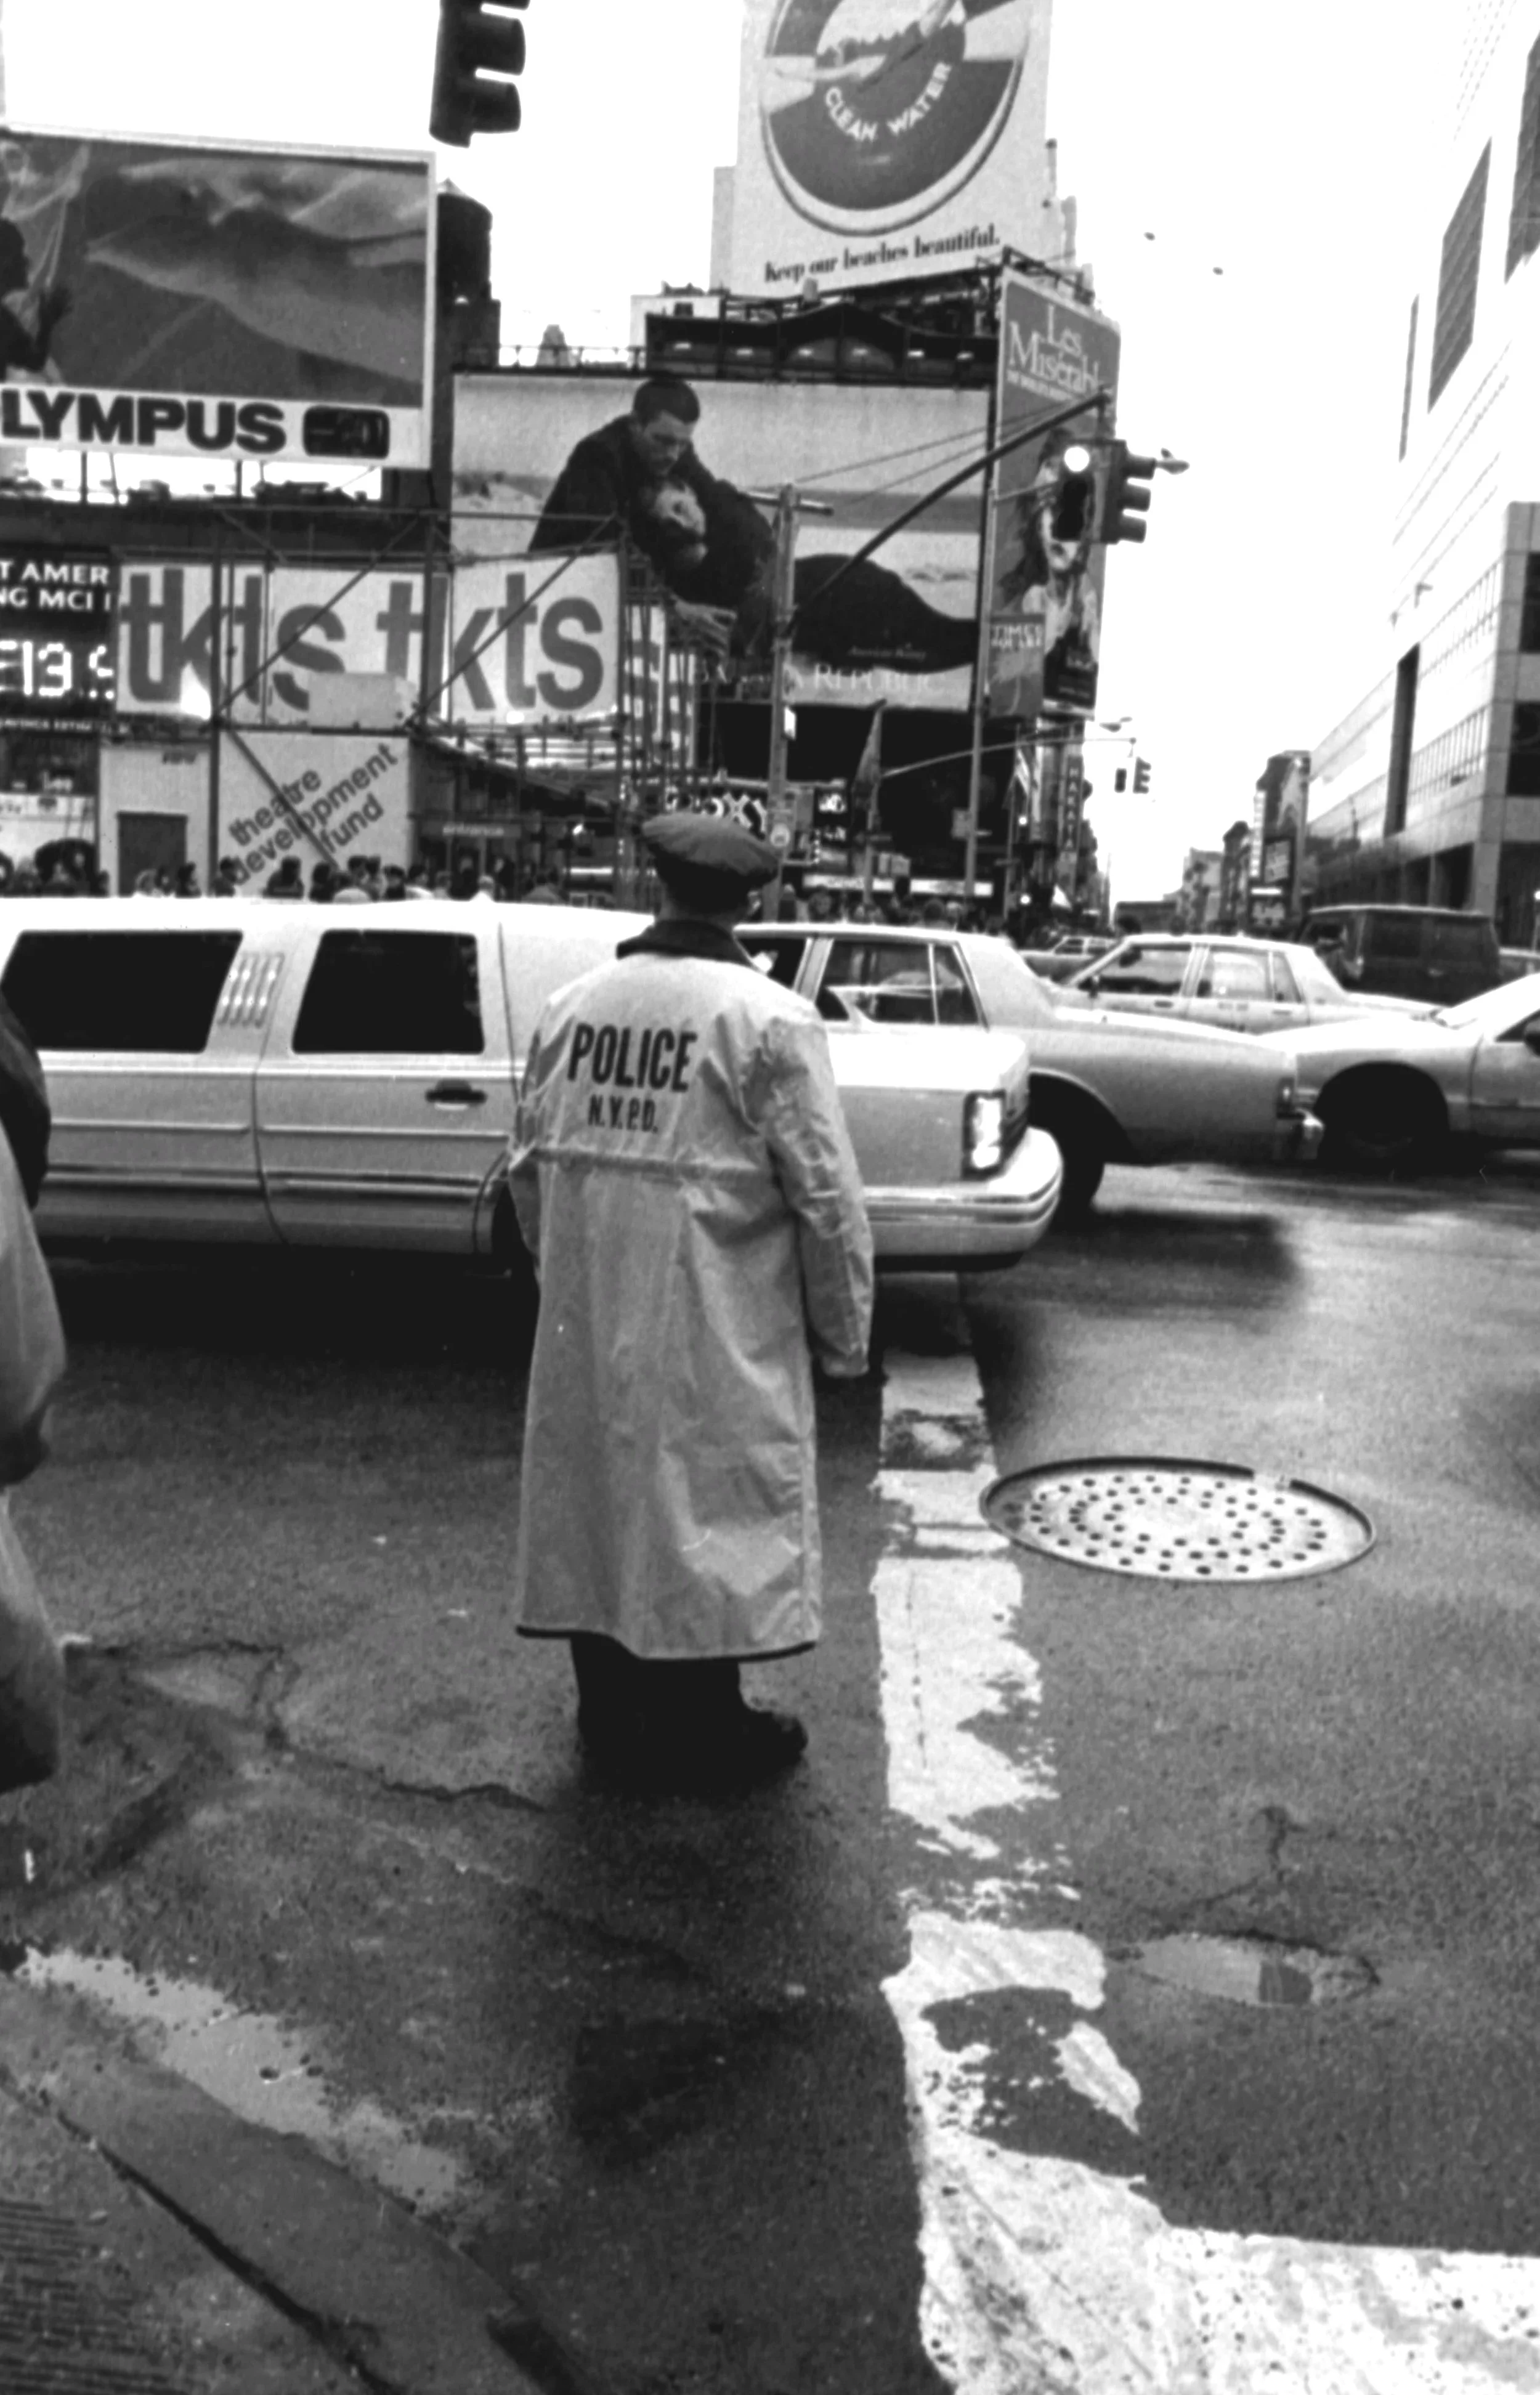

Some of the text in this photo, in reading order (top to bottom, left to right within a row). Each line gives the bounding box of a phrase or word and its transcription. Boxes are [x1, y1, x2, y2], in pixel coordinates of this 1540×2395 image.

[825, 62, 952, 142] CLEAN WATER
[764, 261, 805, 284] Keep
[809, 257, 838, 275] our
[843, 243, 910, 270] beaches
[1, 388, 287, 454] LYMPUS
[39, 588, 92, 610] MCI
[567, 1021, 699, 1093] POLICE
